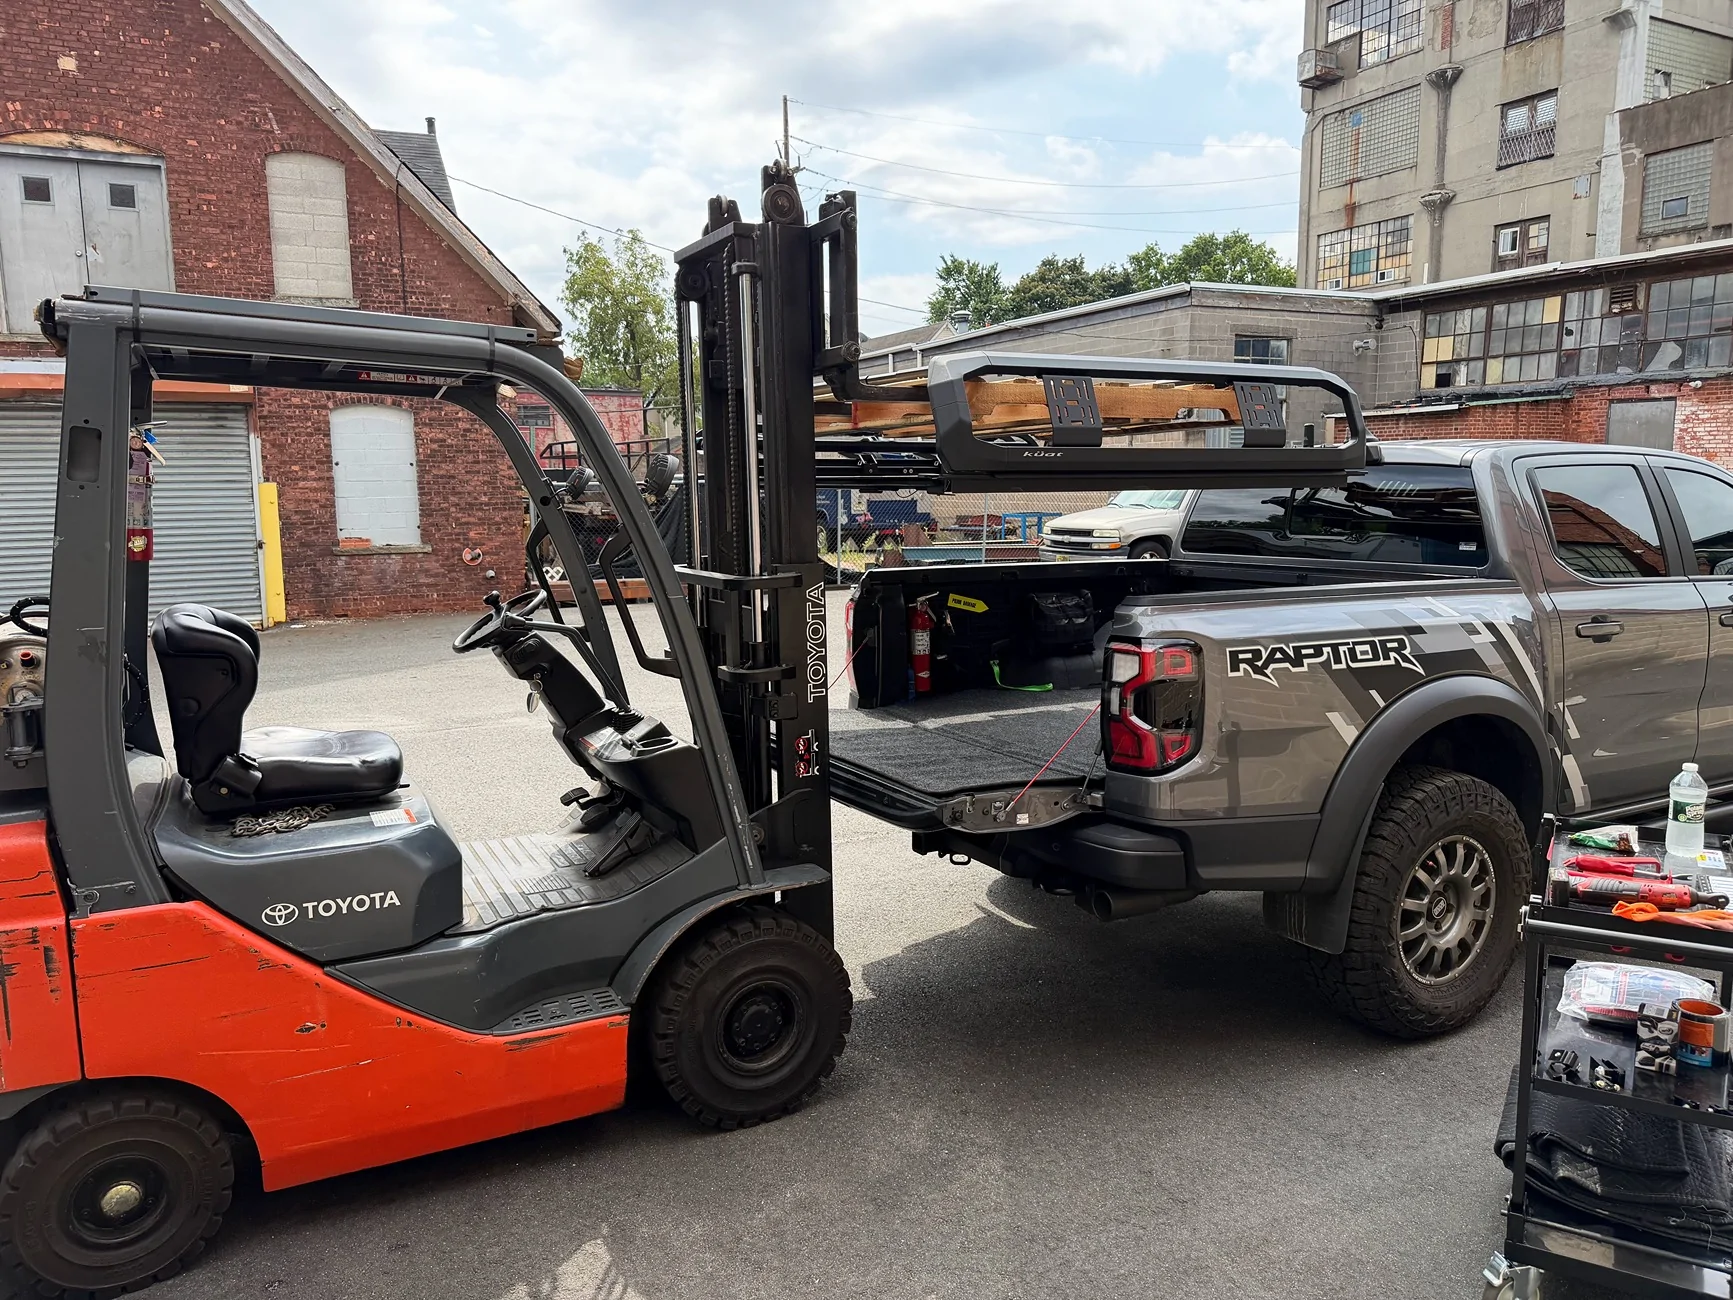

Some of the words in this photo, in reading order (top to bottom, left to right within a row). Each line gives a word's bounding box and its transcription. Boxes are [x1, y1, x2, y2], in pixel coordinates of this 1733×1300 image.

[806, 581, 826, 703] TOYOTA
[1226, 635, 1426, 688] RAPTOR
[302, 890, 401, 919] TOYOTA
